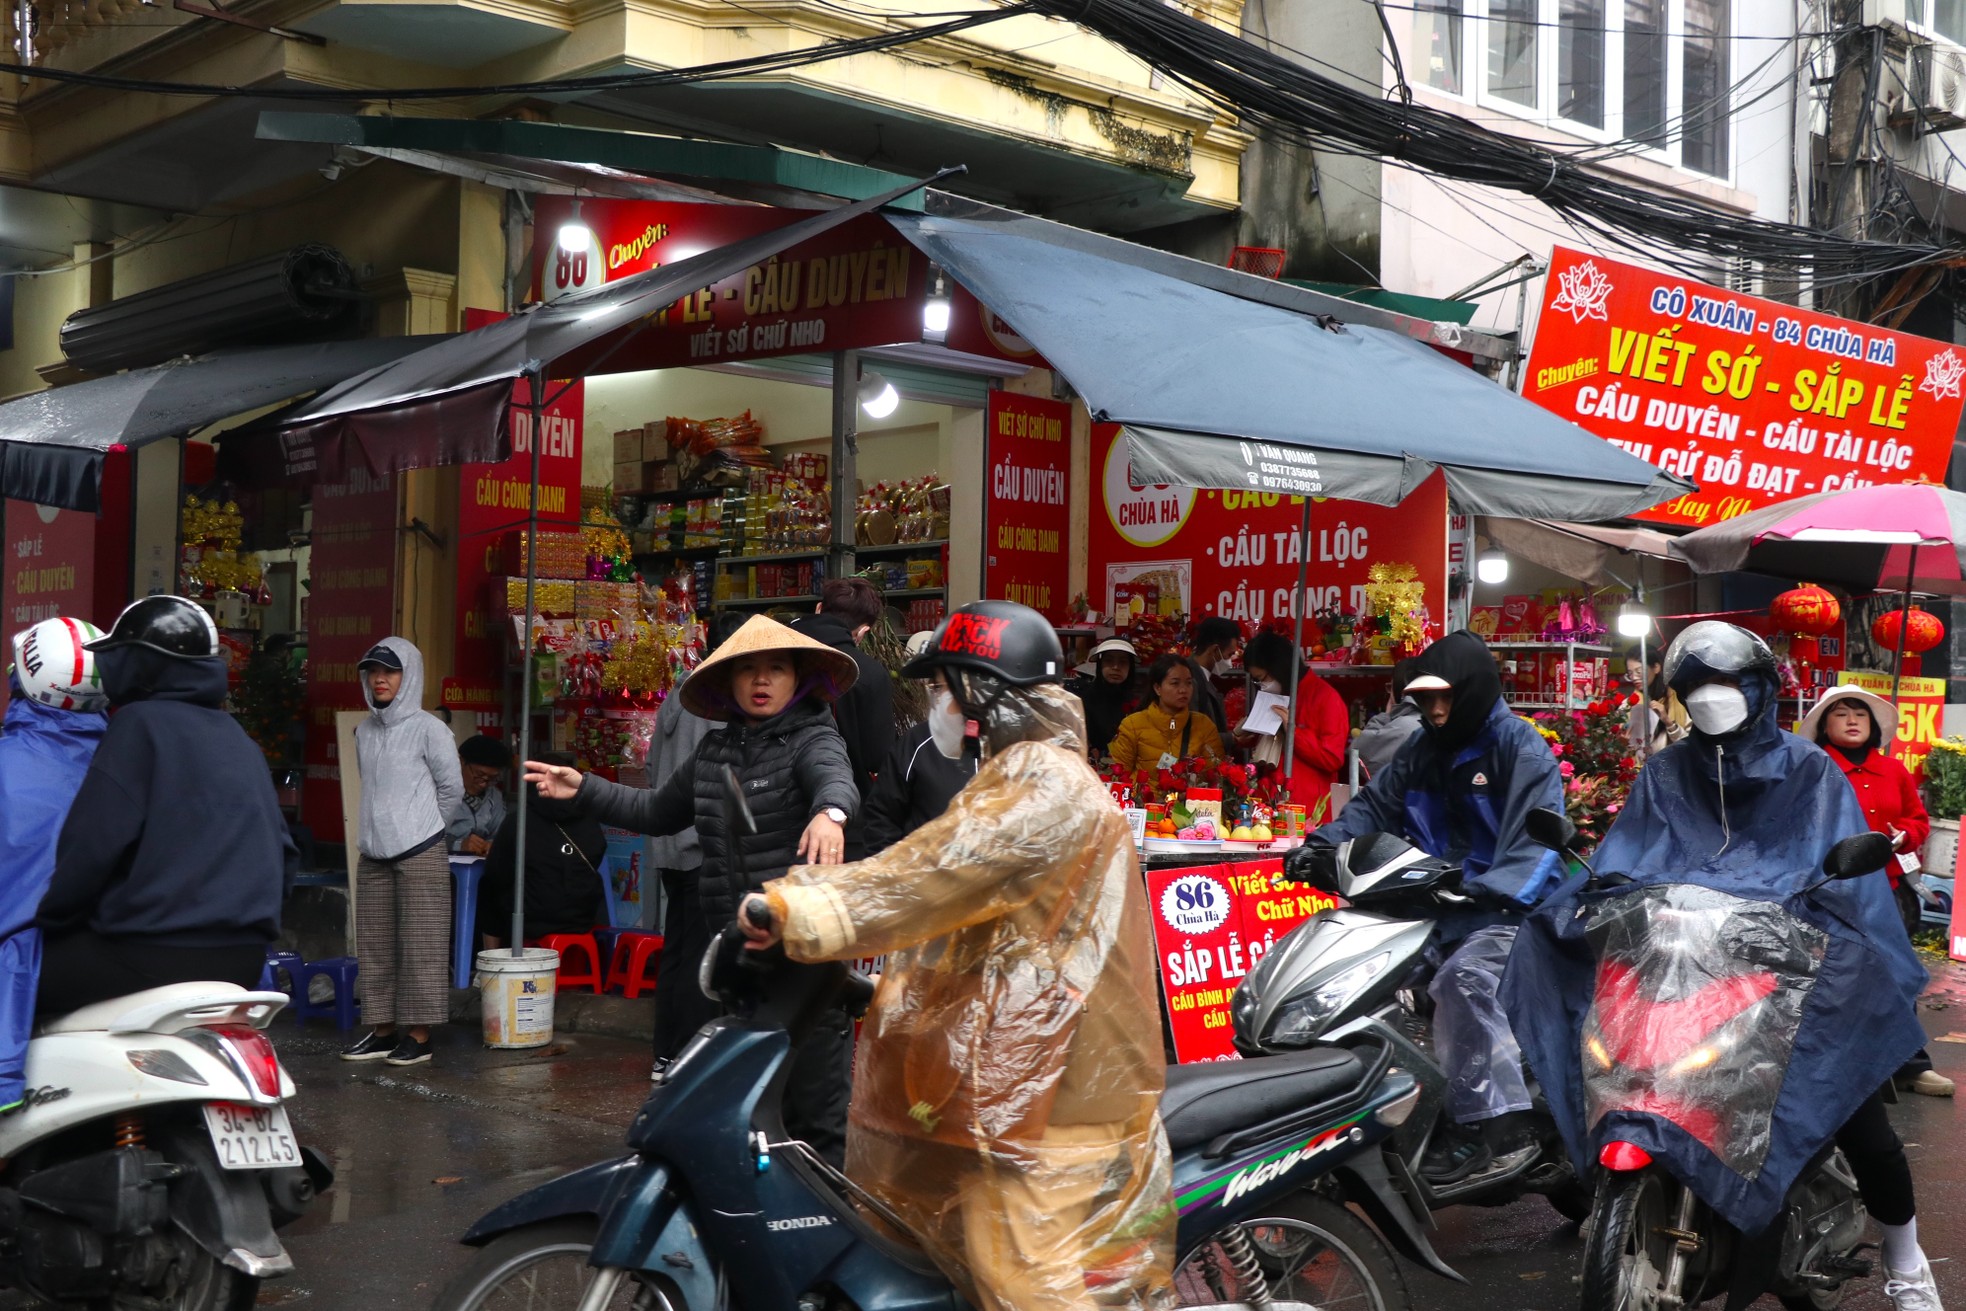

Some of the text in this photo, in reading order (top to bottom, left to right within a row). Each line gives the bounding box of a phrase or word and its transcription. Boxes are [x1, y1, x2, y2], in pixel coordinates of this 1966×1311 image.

[609, 223, 668, 270] Chuyên:
[806, 240, 911, 309] DUYÊN
[690, 324, 722, 357] VIẾT
[753, 318, 787, 351] CHỮ
[790, 319, 825, 347] NHO
[1650, 286, 1686, 318] CÔ
[1687, 295, 1756, 334] XUÂN
[1772, 316, 1802, 346] 84
[1805, 325, 1863, 359] CHÙA
[1866, 335, 1896, 367] HÀ
[1537, 357, 1600, 390] Chuyên:
[1608, 324, 1697, 387] VIẾT
[1702, 343, 1763, 401] SỚ
[1790, 361, 1865, 419] SẮP
[1869, 374, 1915, 430] LỄ
[998, 404, 1015, 436] VIẾT
[1046, 419, 1062, 442] NHO
[1575, 381, 1640, 424] CẦU
[1645, 393, 1741, 442] DUYÊN
[1763, 417, 1818, 455] CẦU
[1823, 427, 1863, 464] TÀI
[1866, 434, 1913, 473] LỘC
[994, 452, 1065, 505] CẦU DUYÊN
[1658, 440, 1703, 476] CỬ
[1703, 449, 1743, 486] ĐỖ
[1746, 463, 1800, 497] ĐẠT
[476, 470, 499, 507] CẦU
[1119, 494, 1180, 526] CHÙA HÀ
[998, 518, 1059, 553] CẦU CÔNG DANH
[1218, 521, 1266, 568] CẦU
[1319, 521, 1368, 568] LỘC
[16, 562, 75, 594] CẦU DUYÊN
[1217, 579, 1265, 621] CẦU
[967, 643, 1000, 660] YOU
[1175, 880, 1215, 911] 86
[1228, 870, 1269, 896] Viết
[1176, 909, 1220, 926] Chùa Hà
[1256, 895, 1335, 920] Chữ Nho
[1167, 932, 1246, 987] SẮP LỄ
[1172, 989, 1195, 1011] CẦU
[1196, 988, 1225, 1007] BÌNH
[1203, 1007, 1226, 1029] CẦU
[220, 1135, 295, 1164] 212.45
[1222, 1150, 1301, 1207] Wave
[766, 1215, 833, 1232] HONDA
